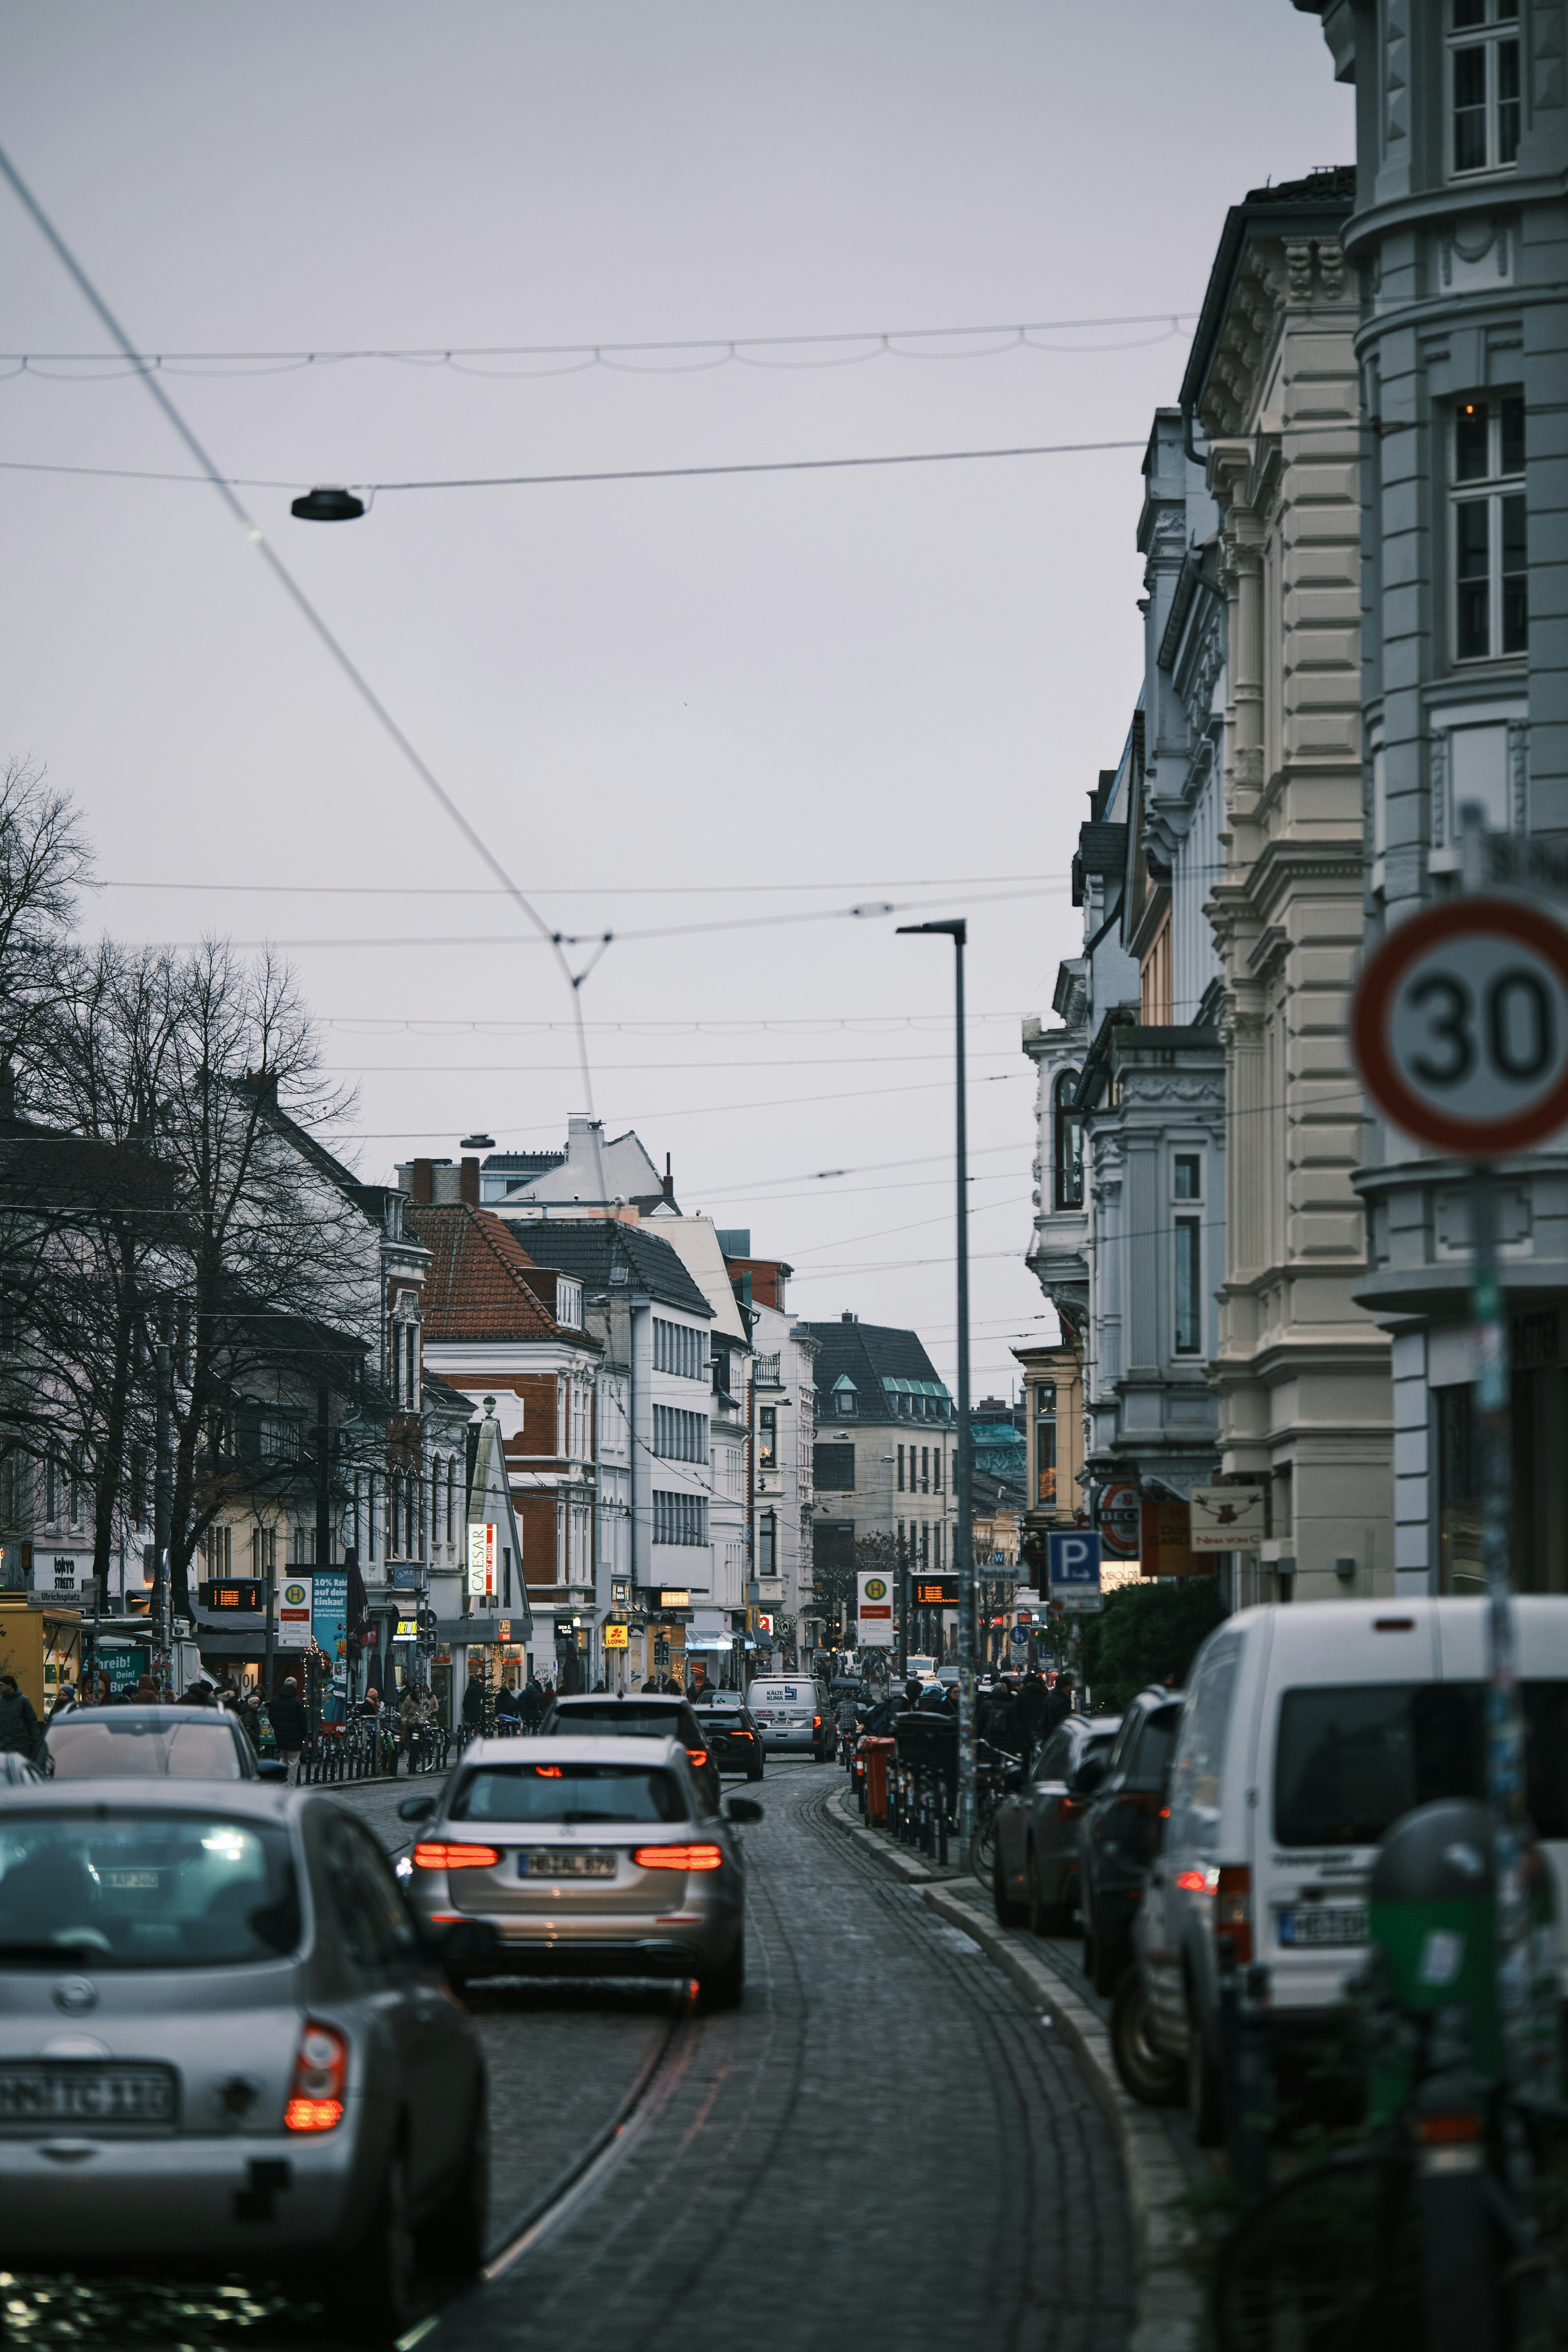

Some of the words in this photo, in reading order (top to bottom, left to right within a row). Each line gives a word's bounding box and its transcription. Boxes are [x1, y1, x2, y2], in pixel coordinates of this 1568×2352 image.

[1408, 969, 1559, 1085] 30
[472, 1529, 484, 1590] CAESAR
[995, 1553, 1003, 1562] W
[1062, 1539, 1088, 1577] P
[397, 1570, 413, 1579] ISME
[54, 1577, 74, 1590] STREETS
[871, 1583, 880, 1595] H
[42, 1592, 80, 1602] Ulrichsplatz
[291, 1589, 300, 1600] H
[83, 1656, 130, 1671] Shreib!
[116, 1670, 135, 1679] Dein!
[110, 1680, 139, 1692] Bu!
